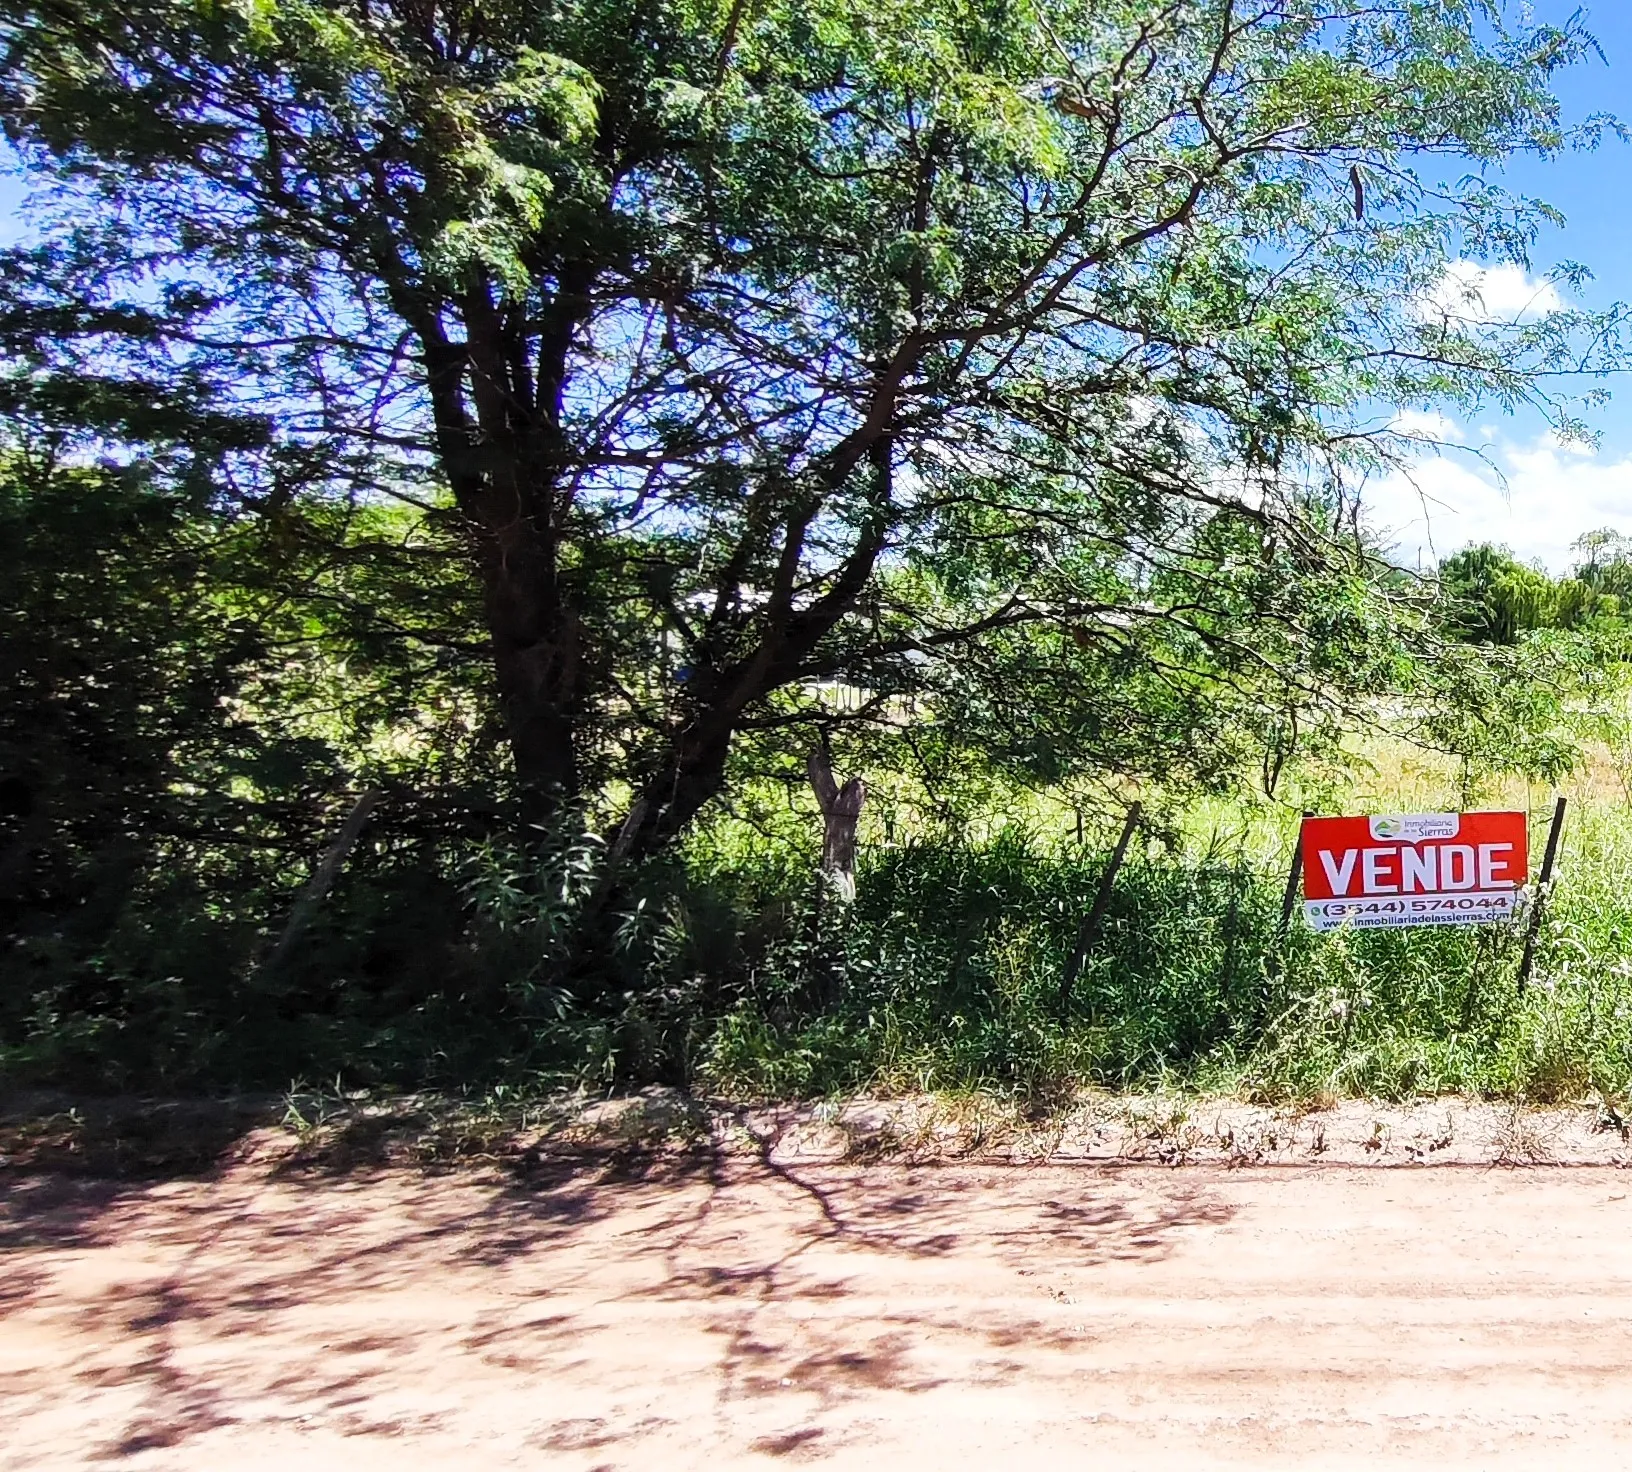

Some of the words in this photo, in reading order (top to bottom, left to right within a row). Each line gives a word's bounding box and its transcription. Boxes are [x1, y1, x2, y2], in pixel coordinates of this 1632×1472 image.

[1418, 827, 1454, 837] Sierras
[1318, 843, 1514, 896] VENDE
[1322, 900, 1406, 917] (3544)
[1411, 897, 1509, 912] 574044
[1322, 912, 1512, 928] ww.inmobiliariadelassierras.com
